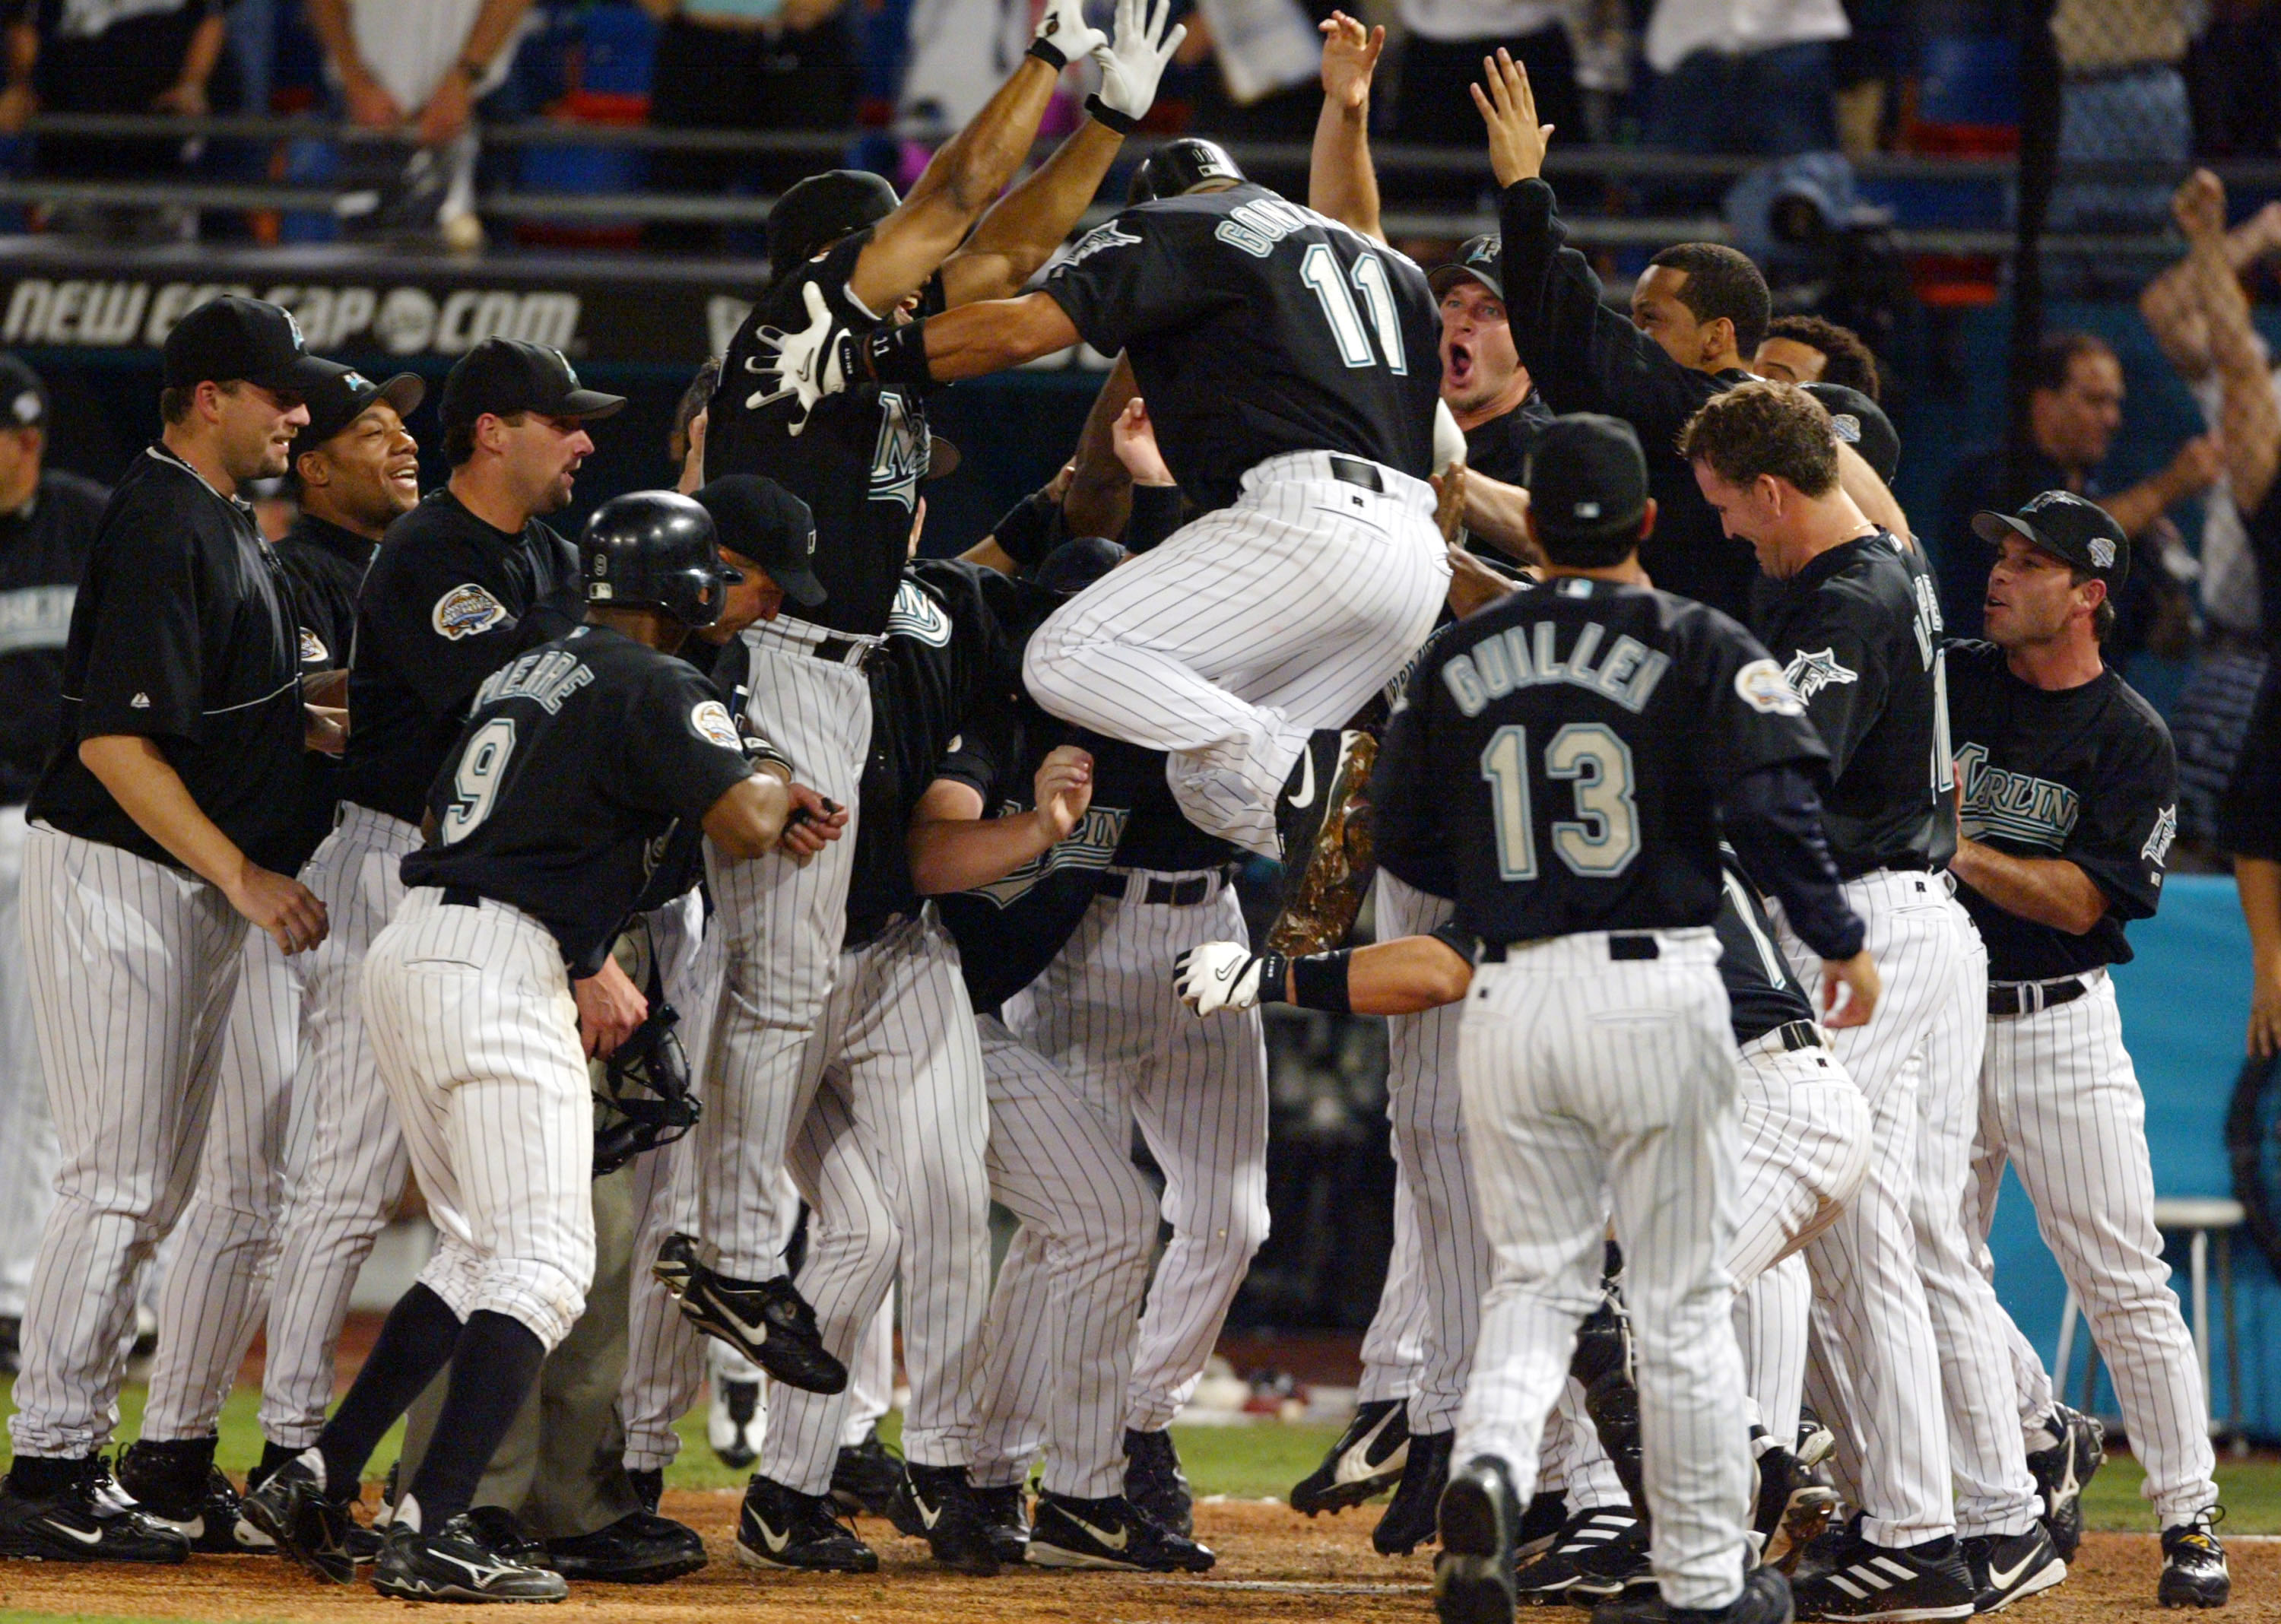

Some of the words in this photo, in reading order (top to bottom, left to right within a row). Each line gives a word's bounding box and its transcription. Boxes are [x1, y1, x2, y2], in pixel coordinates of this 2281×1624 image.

[1299, 243, 1407, 376] 11
[442, 718, 517, 846] 9
[1480, 722, 1642, 881] 13
